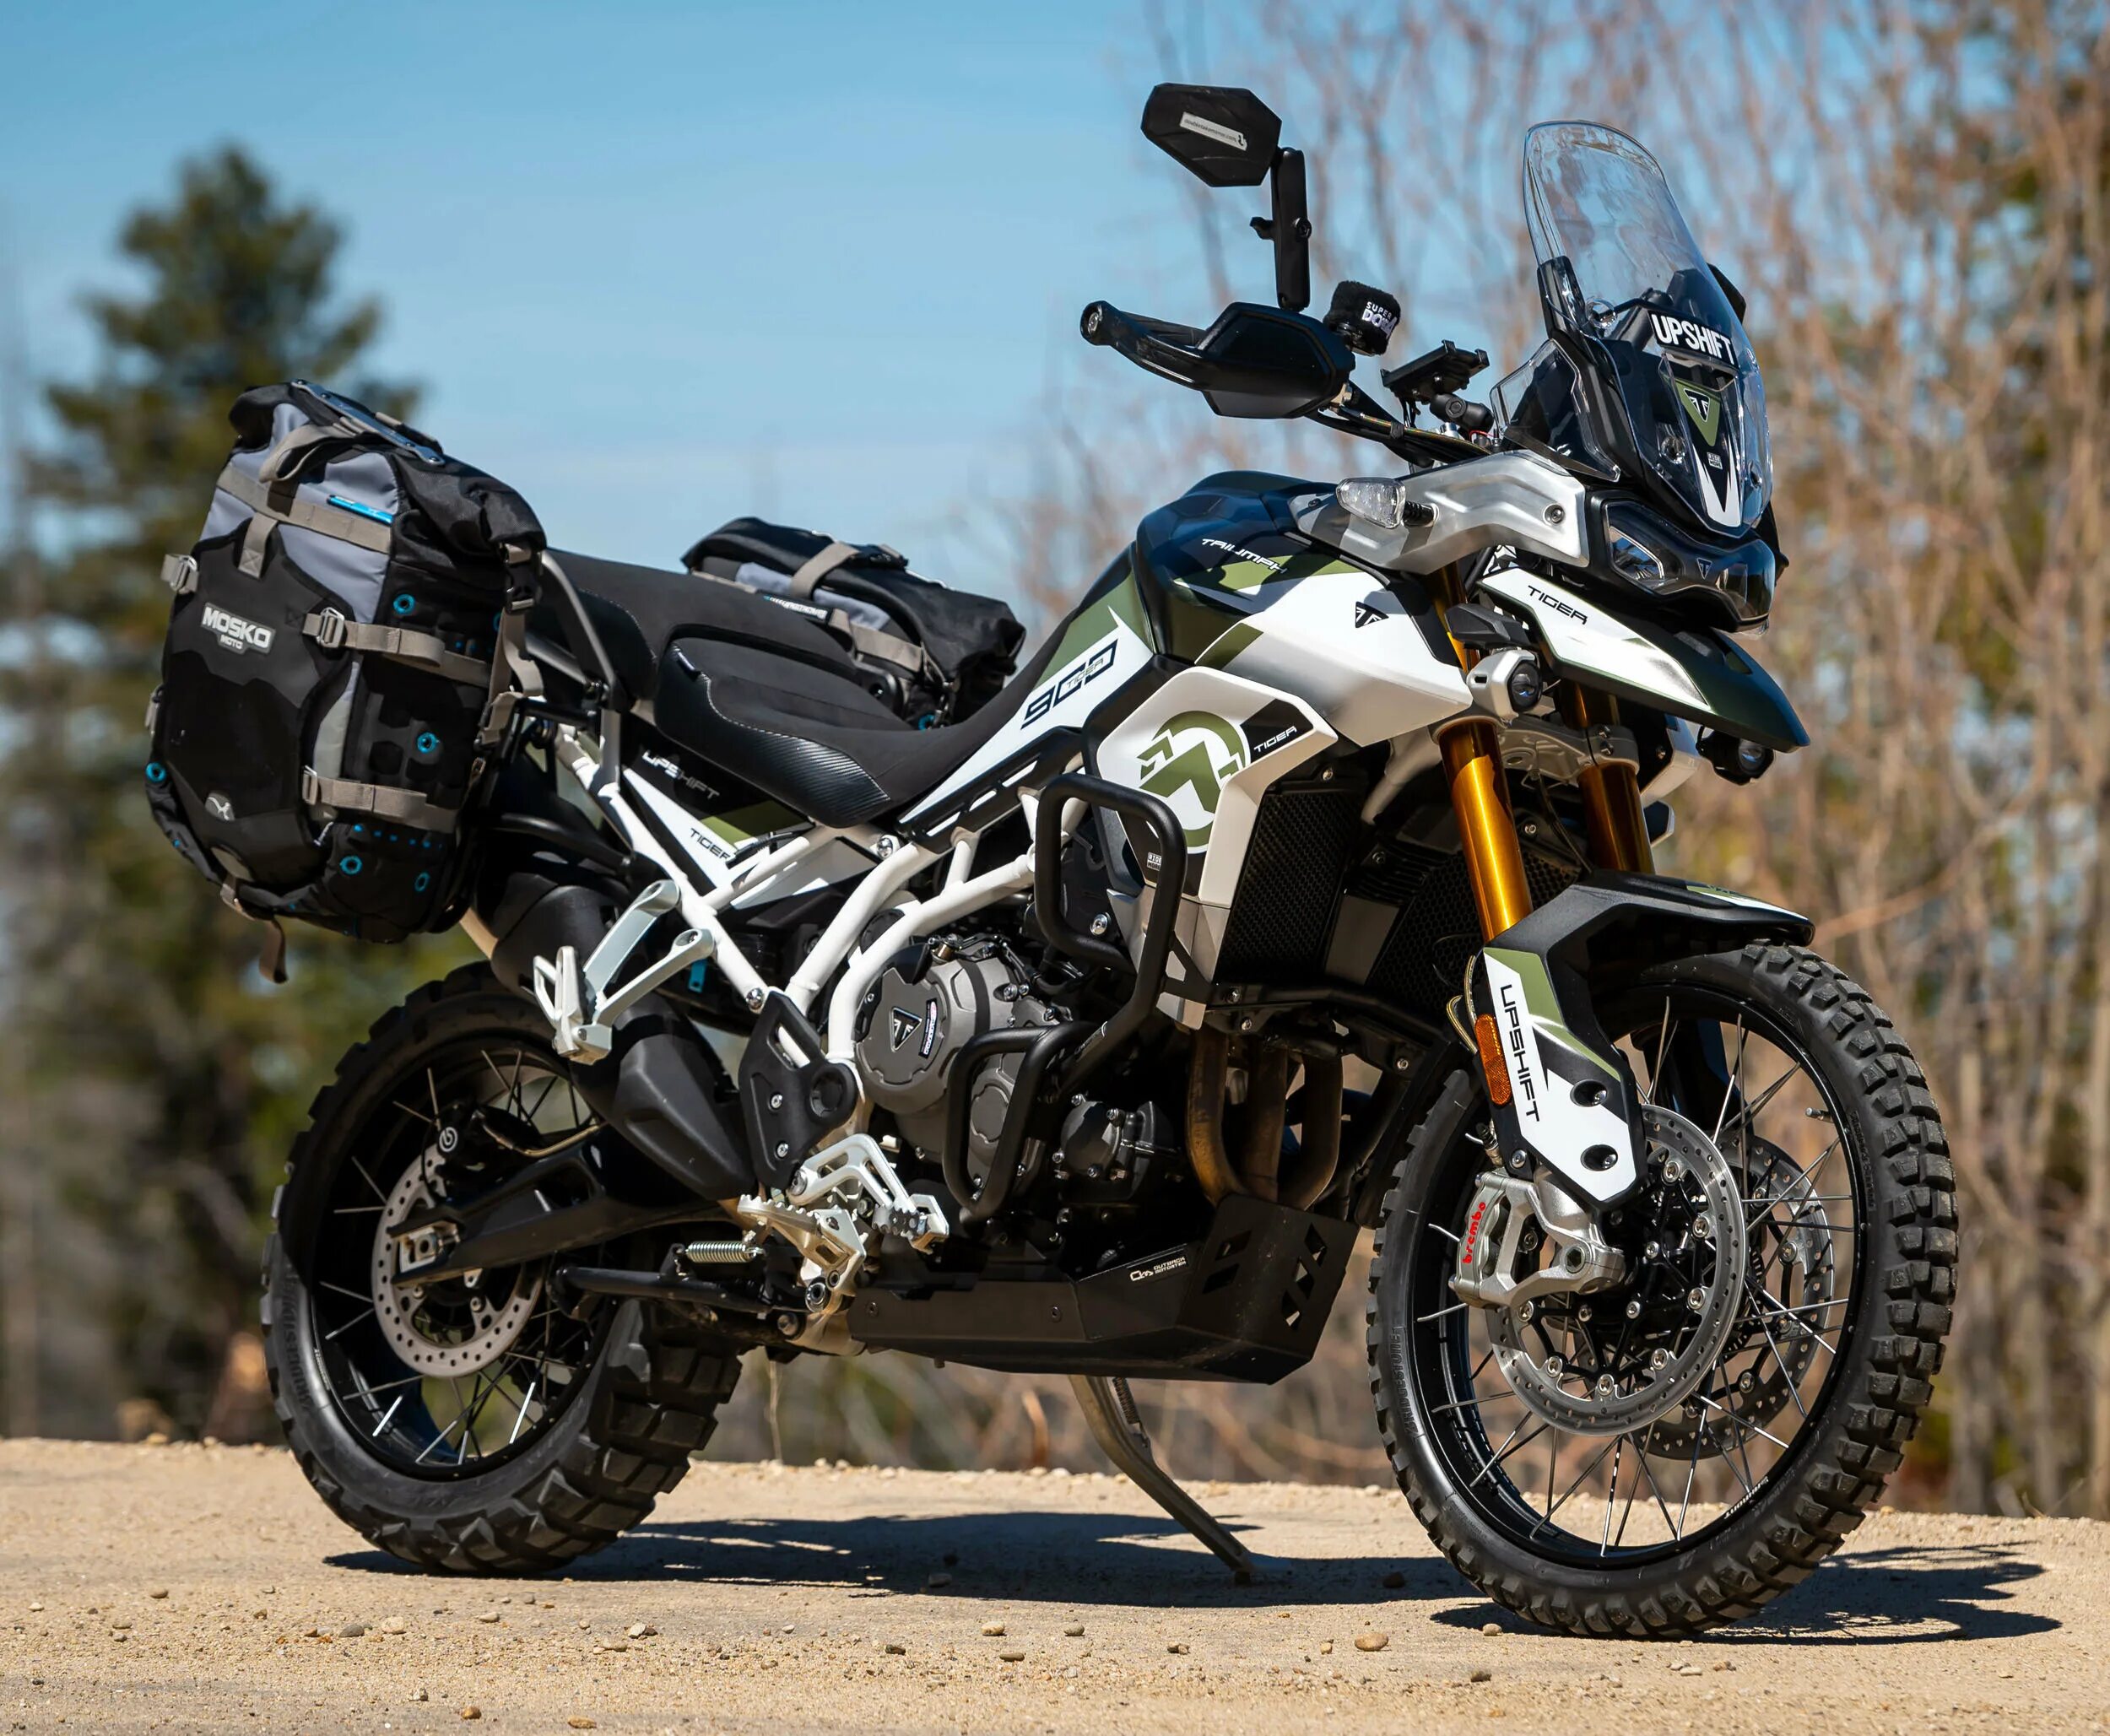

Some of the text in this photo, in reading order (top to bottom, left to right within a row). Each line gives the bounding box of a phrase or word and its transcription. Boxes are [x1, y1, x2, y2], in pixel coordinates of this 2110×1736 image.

[1366, 301, 1392, 320] SUPER
[1651, 313, 1735, 365] UPSHIFT
[1201, 538, 1288, 574] TRIUMPH
[1528, 585, 1588, 625] TIGER
[203, 606, 272, 648] MOSKO
[220, 634, 243, 650] MOTO
[1020, 639, 1118, 731] 900
[1067, 657, 1104, 689] TIGER
[1253, 725, 1297, 752] TIGER
[642, 749, 720, 799] UPSHIFT
[690, 828, 731, 859] TIGER
[1500, 984, 1540, 1122] UPSHIFT
[1462, 1202, 1486, 1264] brembo
[1391, 1328, 1420, 1433] BRIDGESTONE
